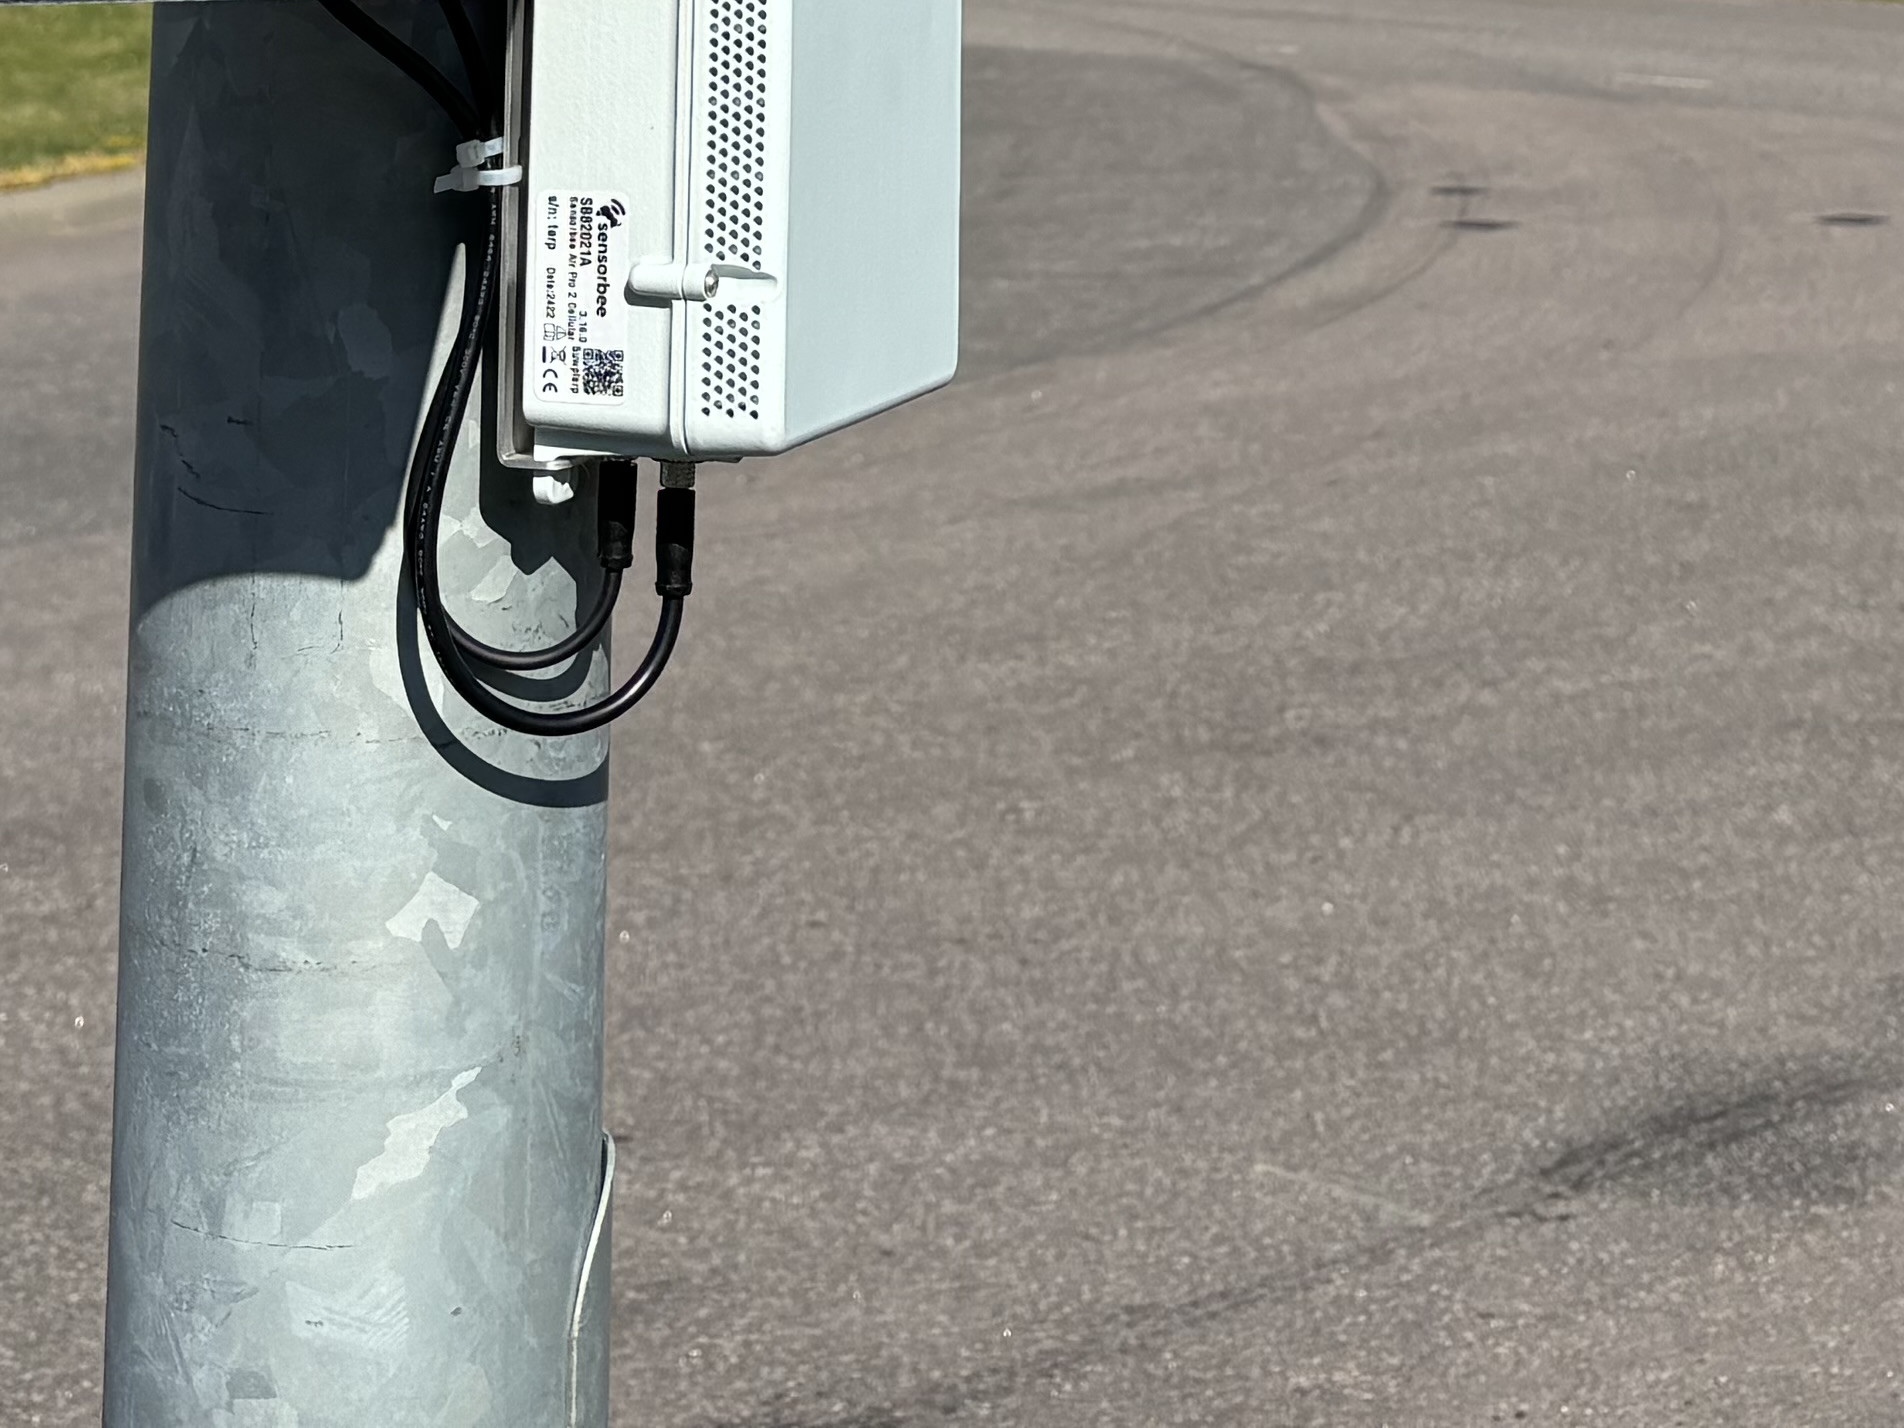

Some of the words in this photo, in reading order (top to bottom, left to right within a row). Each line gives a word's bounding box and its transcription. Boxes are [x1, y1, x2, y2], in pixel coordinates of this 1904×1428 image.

[568, 253, 577, 268] Air
[596, 222, 611, 317] sensorbee
[568, 271, 577, 288] Pro
[567, 291, 577, 299] 2
[567, 302, 577, 341] Cellular
